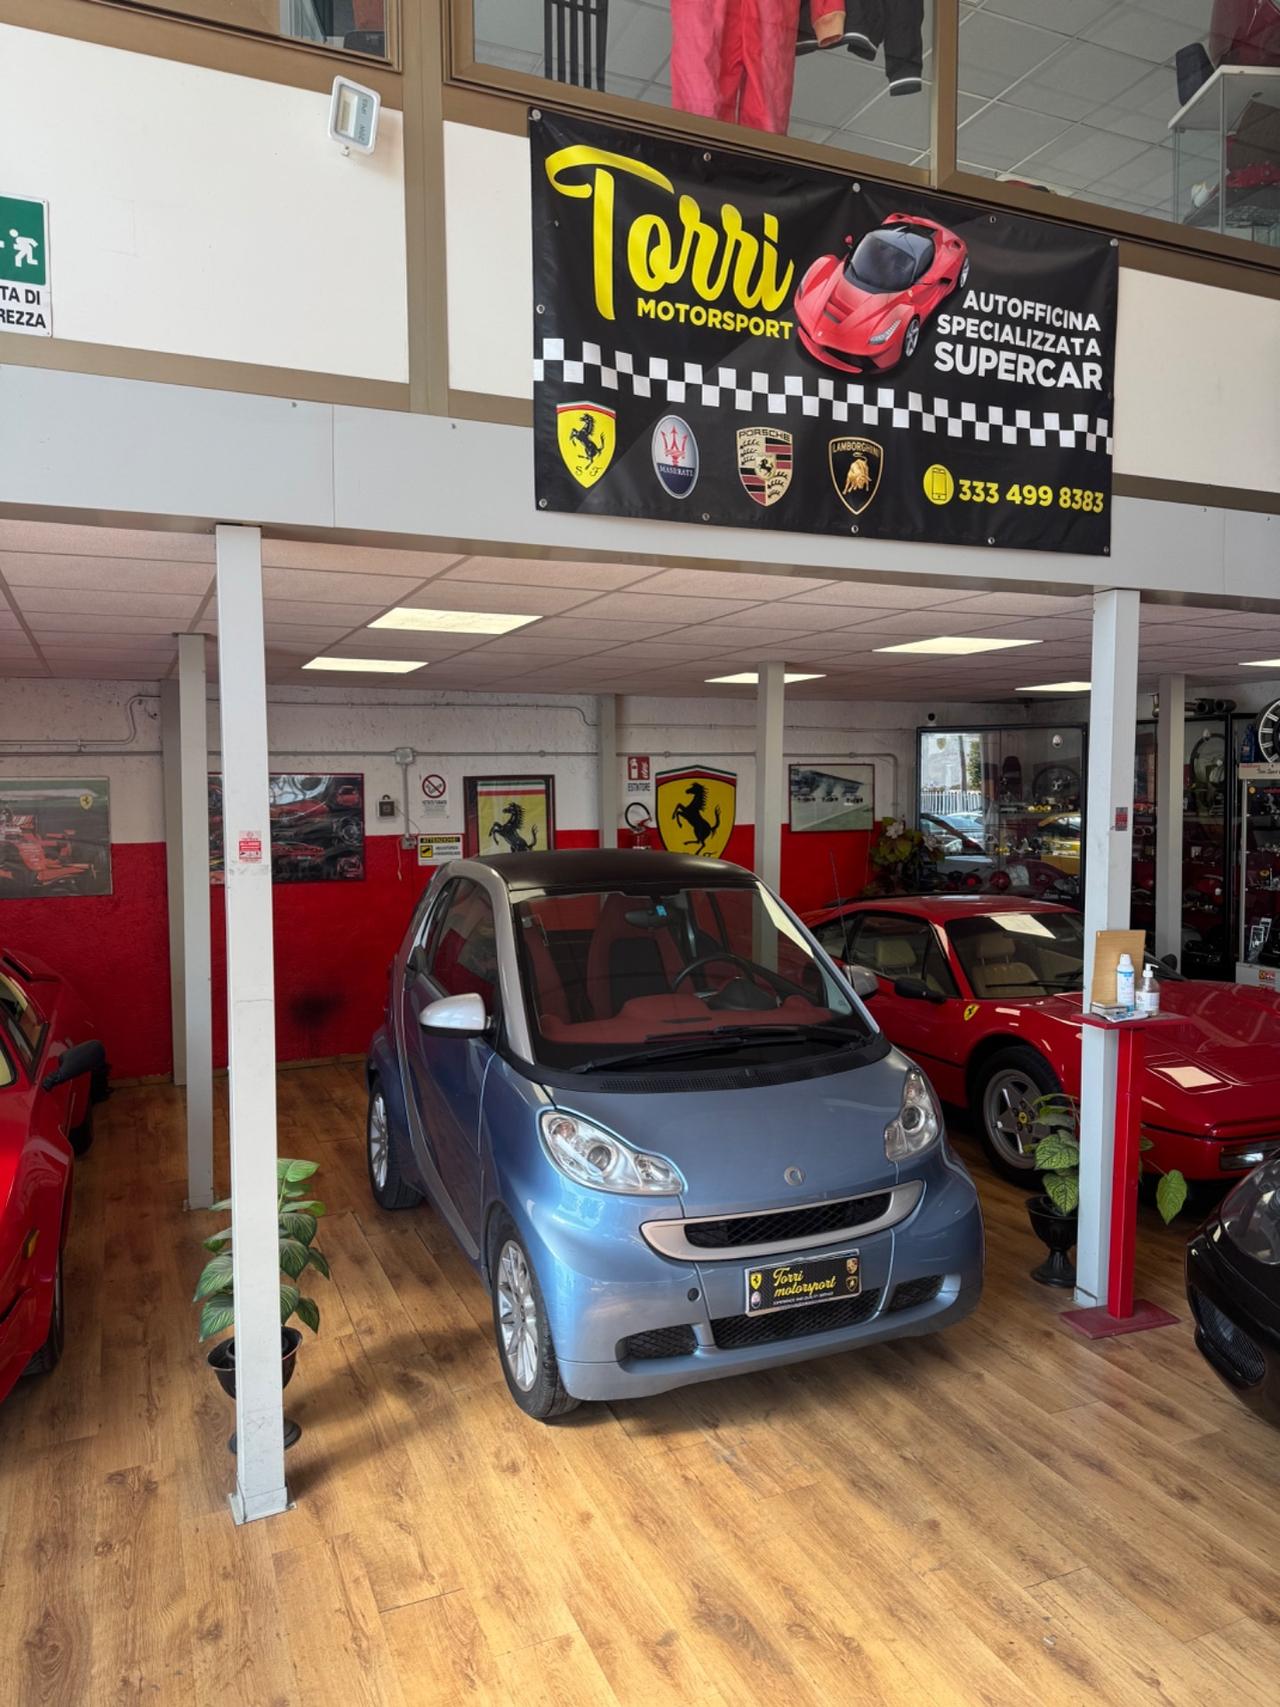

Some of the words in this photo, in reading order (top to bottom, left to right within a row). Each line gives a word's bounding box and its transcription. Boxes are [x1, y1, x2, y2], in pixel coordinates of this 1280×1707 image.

[545, 144, 795, 321] Torri
[25, 289, 40, 306] DI
[962, 289, 1101, 332] AUTOFFICINA
[637, 297, 793, 340] MOTORSPORT
[936, 314, 1102, 357] SPECIALIZZATA
[934, 341, 1103, 391] SUPERCAR
[738, 428, 791, 441] PORSCHE
[659, 464, 695, 477] MASERATI
[958, 478, 1000, 505] 333
[1006, 484, 1053, 507] 499
[1059, 486, 1104, 514] 8383
[772, 1267, 804, 1287] Torri
[774, 1275, 837, 1298] motorsport
